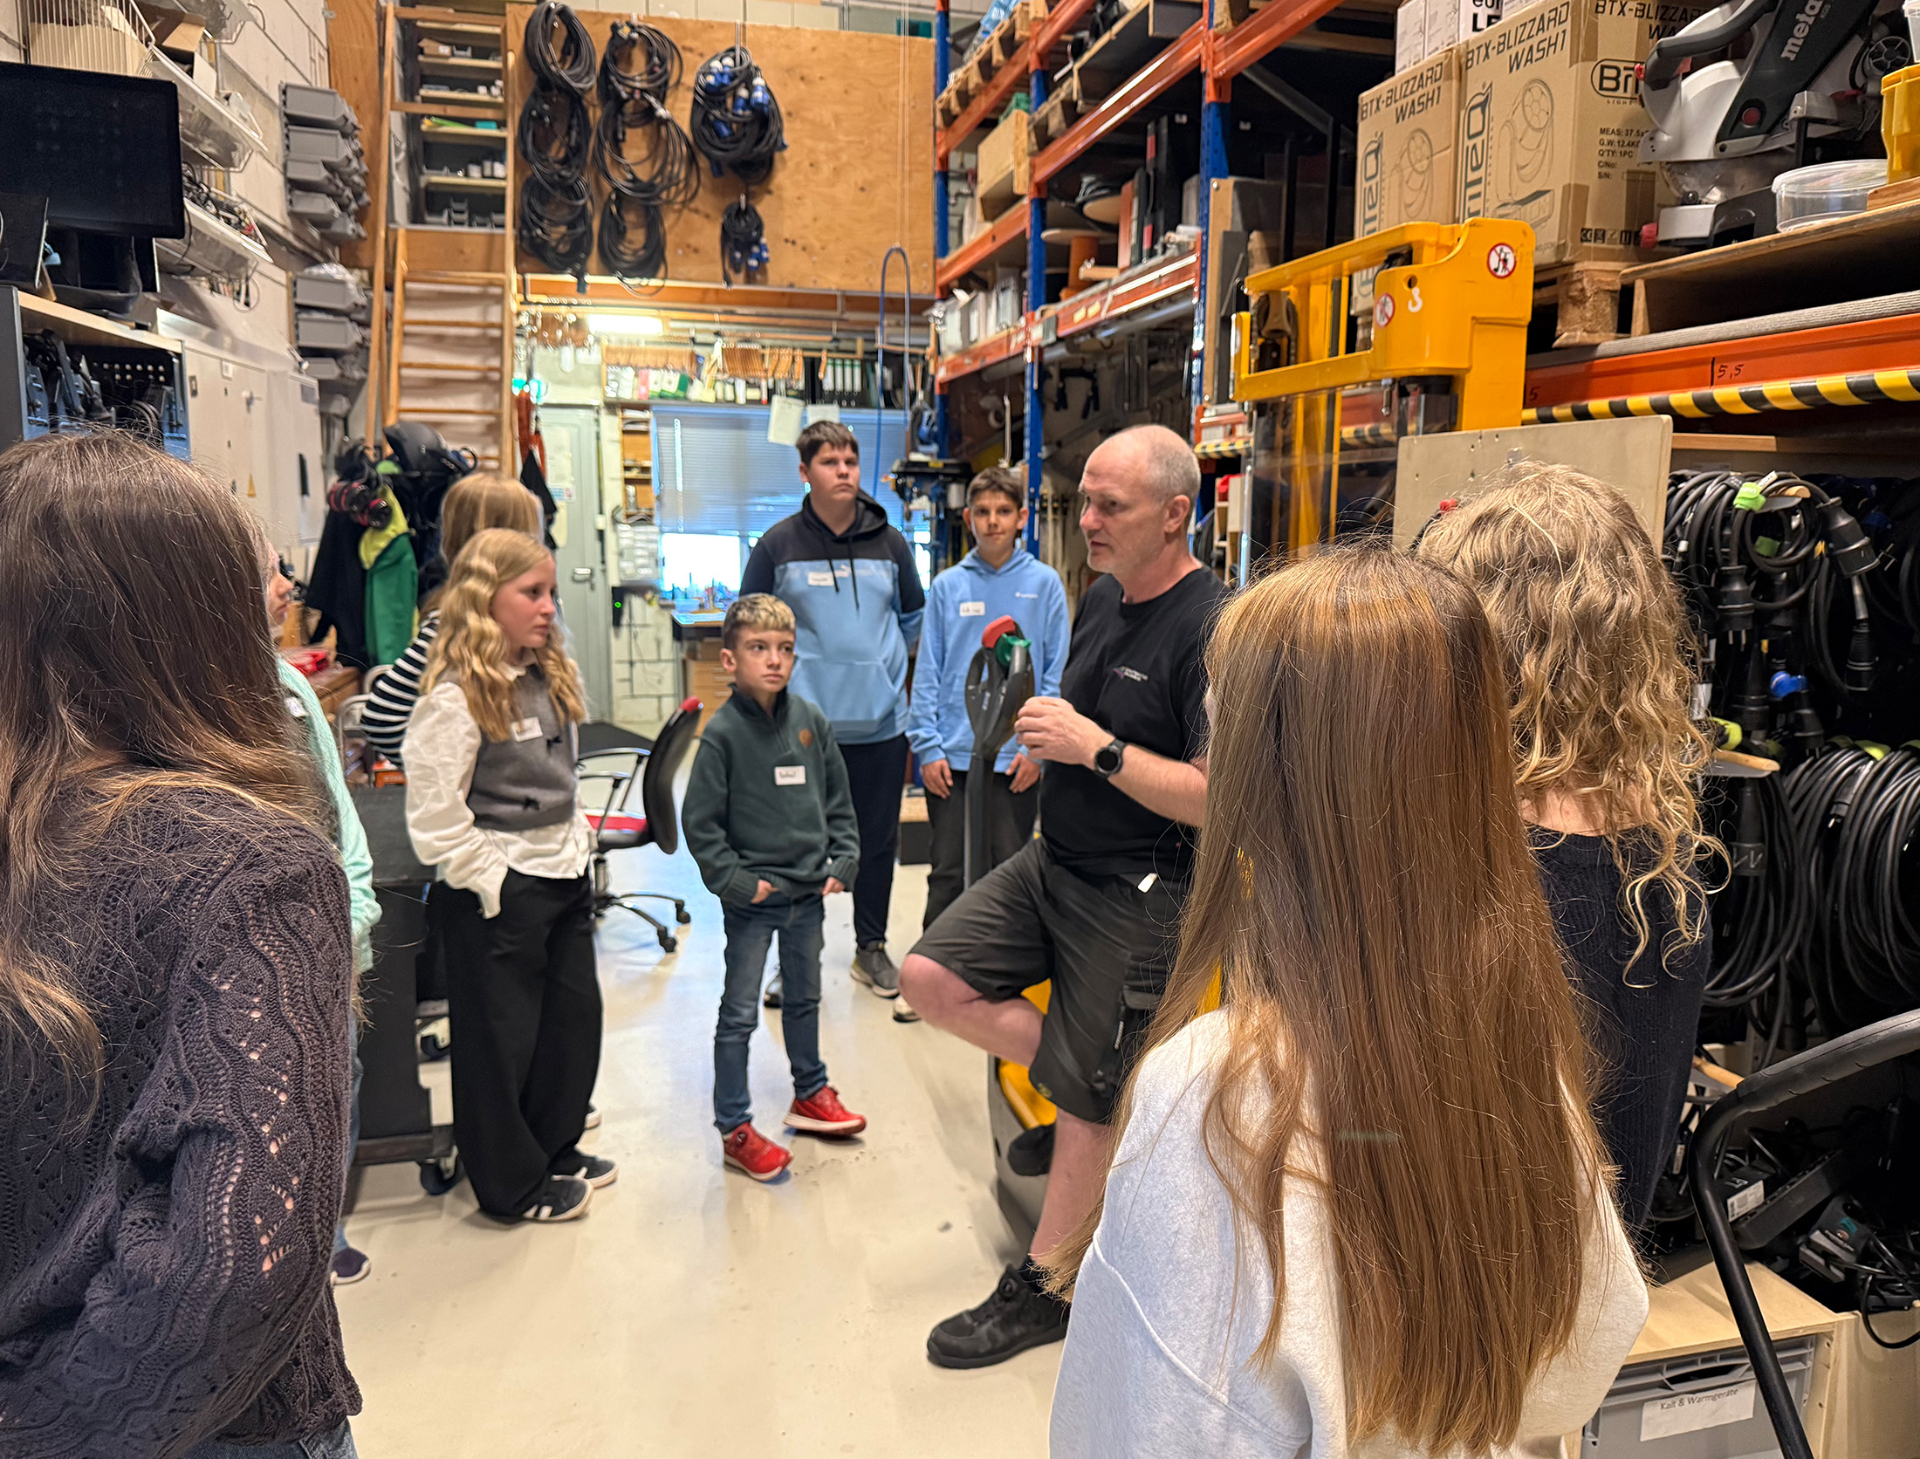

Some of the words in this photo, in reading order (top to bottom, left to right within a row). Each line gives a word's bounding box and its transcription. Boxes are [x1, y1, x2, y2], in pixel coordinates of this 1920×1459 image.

[1595, 0, 1709, 22] BTX-BLIZZAR
[1465, 1, 1570, 70] BTX-BLIZZARD
[1360, 61, 1443, 121] BTX-BLIZZARD
[1678, 1398, 1685, 1407] &
